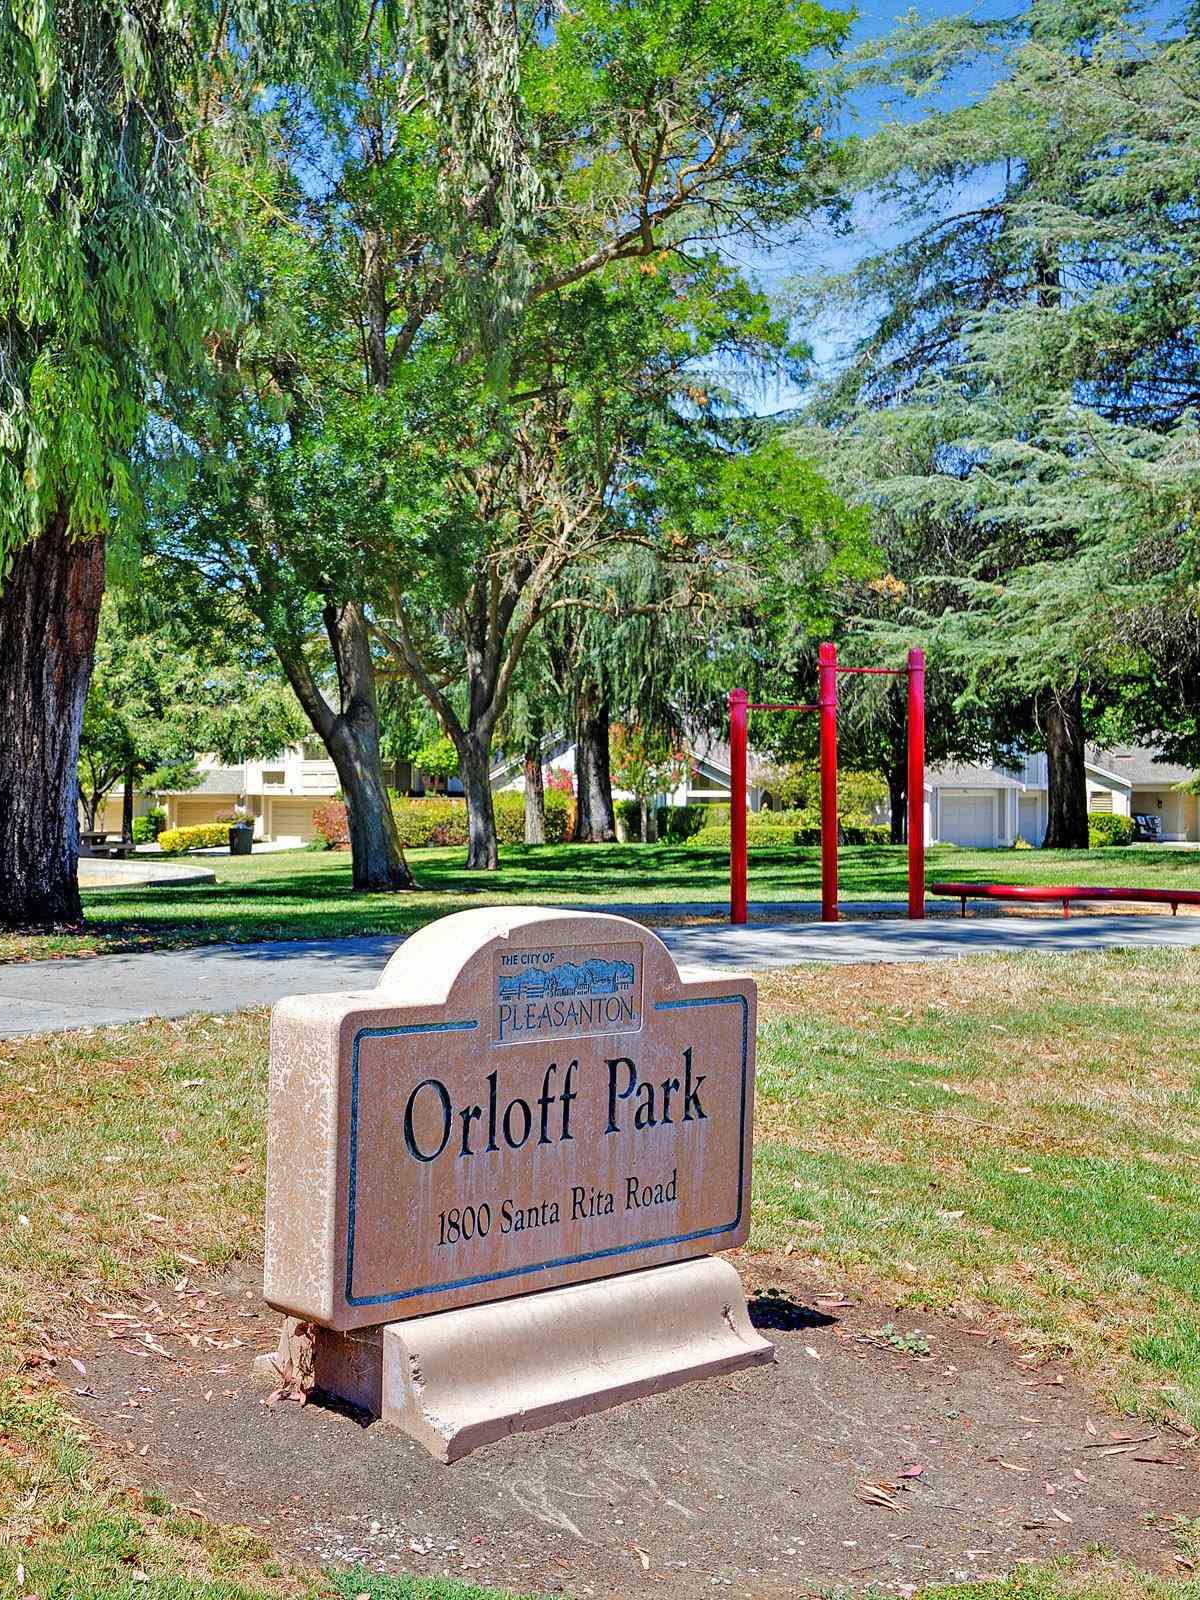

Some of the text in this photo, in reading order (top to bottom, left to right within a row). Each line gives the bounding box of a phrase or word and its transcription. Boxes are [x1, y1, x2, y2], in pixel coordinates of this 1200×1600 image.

[501, 952, 555, 966] THE CITY OF
[499, 996, 635, 1040] PLEASANTON
[403, 1046, 707, 1163] Orloff Park
[438, 1169, 678, 1246] 1800 Santa Rita Road
